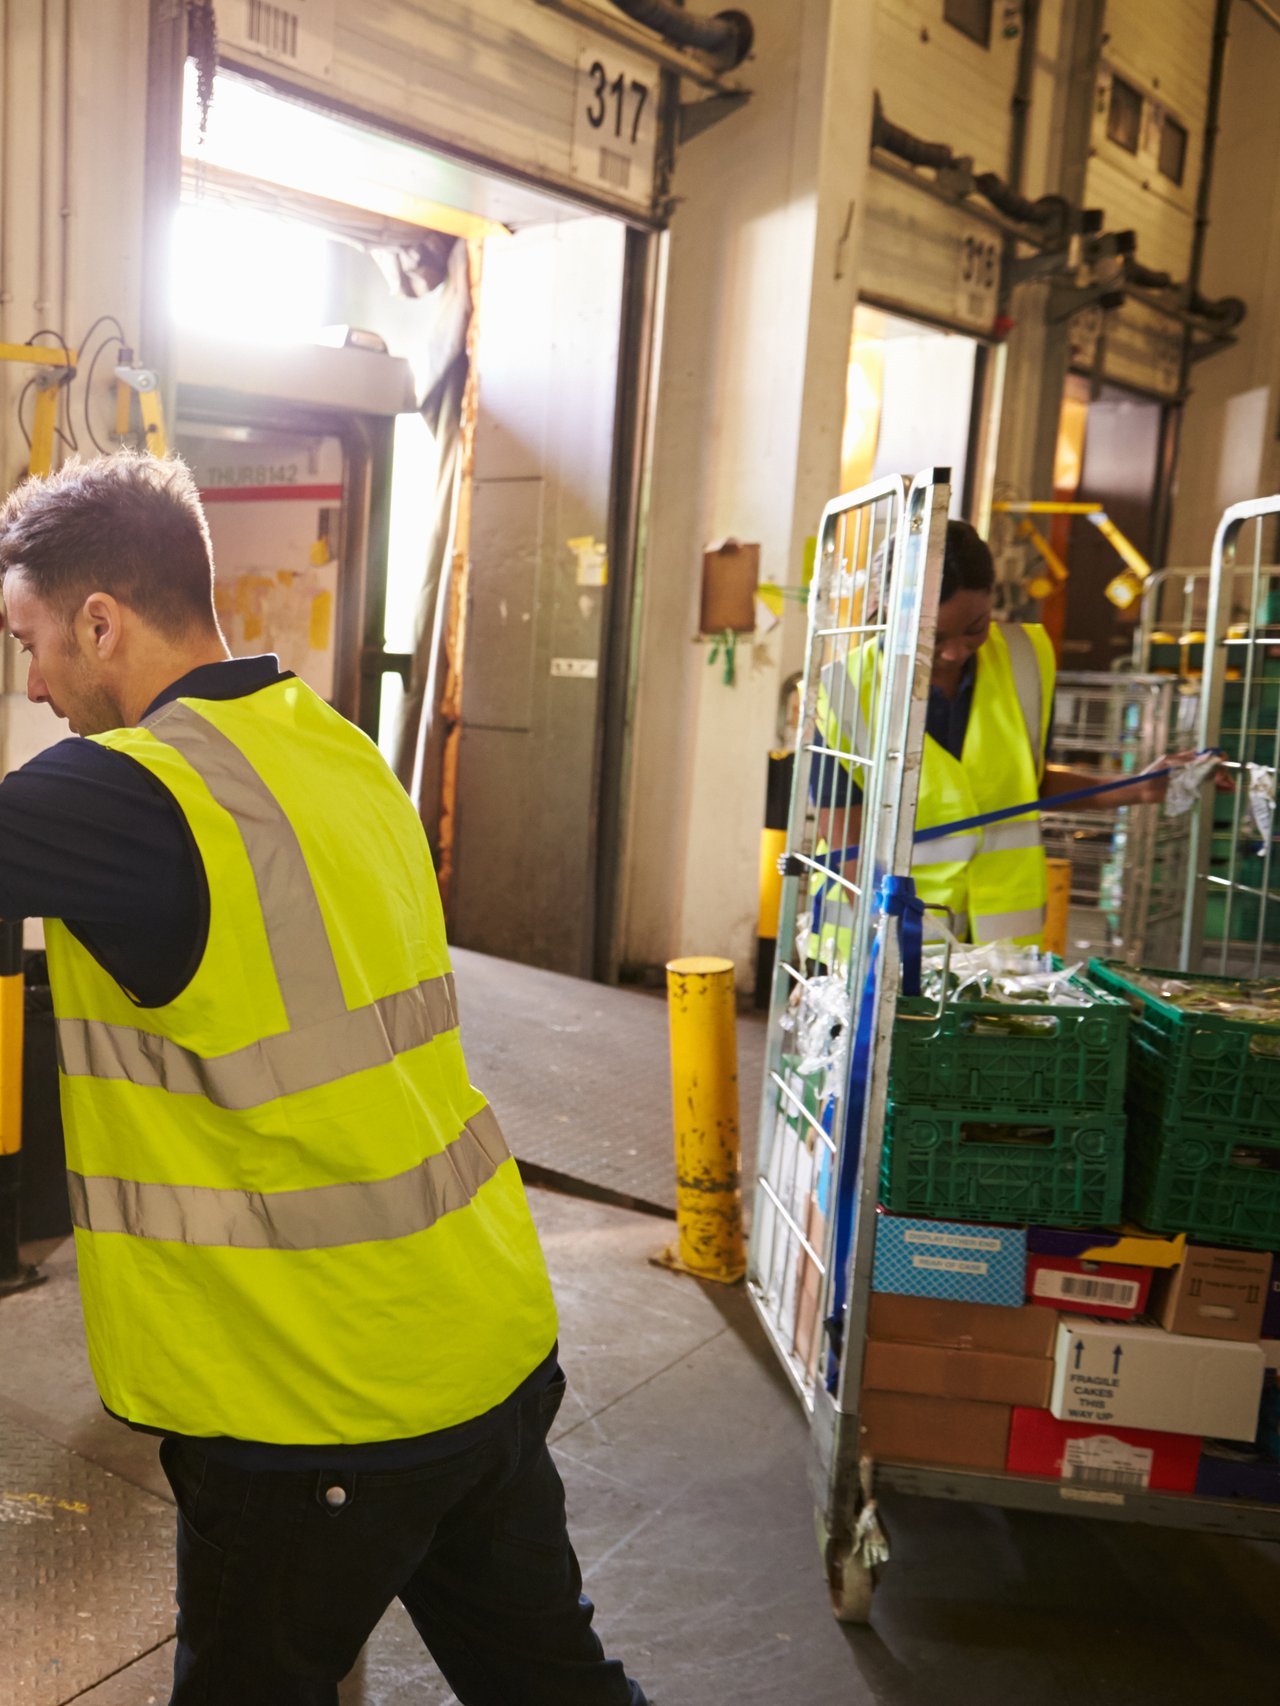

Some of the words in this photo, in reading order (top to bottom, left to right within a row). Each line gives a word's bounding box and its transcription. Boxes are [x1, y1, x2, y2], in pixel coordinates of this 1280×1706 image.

[586, 61, 649, 144] 317
[946, 1236, 976, 1246] OTHER
[978, 1239, 998, 1249] END
[945, 1260, 957, 1269] OF
[959, 1261, 983, 1271] CASE
[1070, 1373, 1120, 1388] FRAGILE
[1073, 1386, 1114, 1398] CAKES
[1079, 1398, 1106, 1409] THIS
[1068, 1409, 1093, 1420] WAY
[1095, 1410, 1114, 1421] UP
